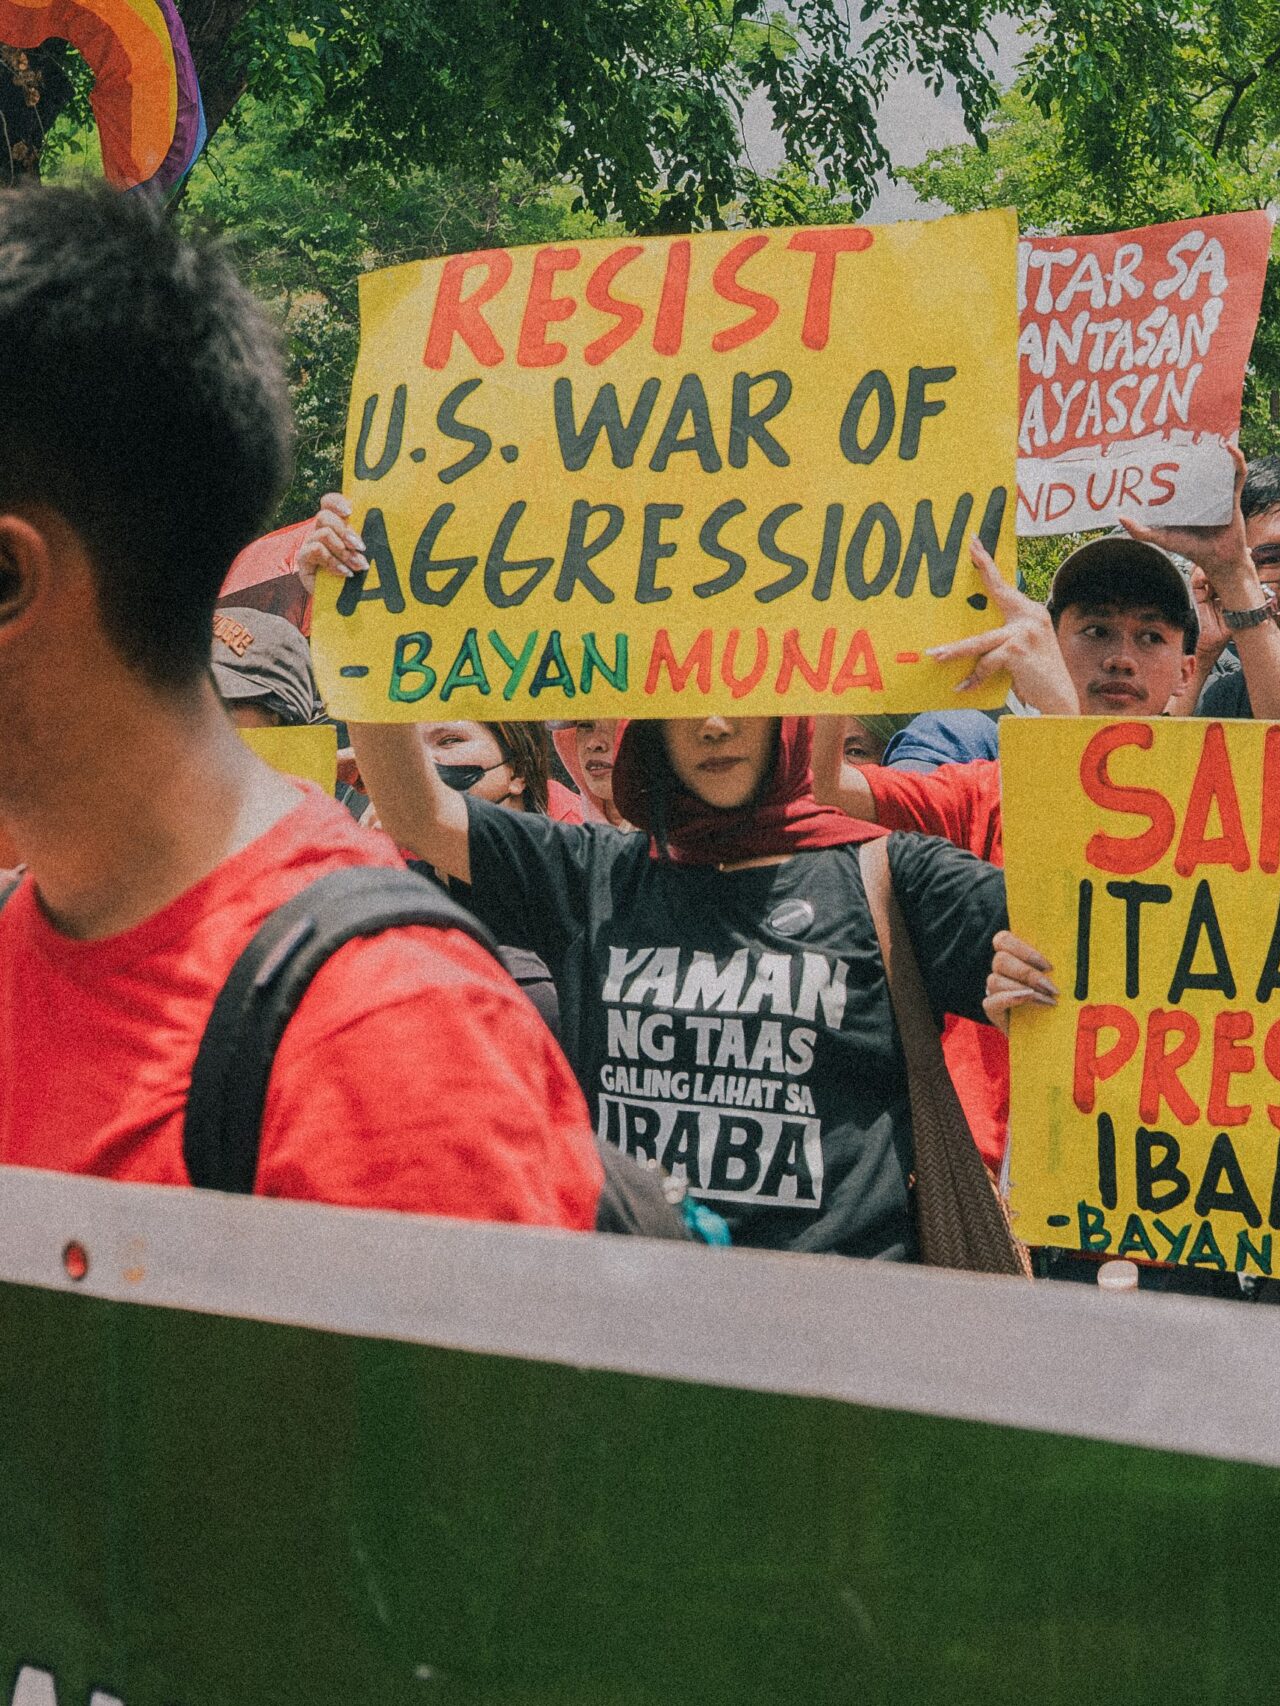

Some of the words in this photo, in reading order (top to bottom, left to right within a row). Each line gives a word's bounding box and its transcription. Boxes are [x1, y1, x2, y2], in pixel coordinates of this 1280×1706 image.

[422, 227, 874, 370] RESIST
[1153, 230, 1228, 300] SA
[354, 377, 519, 484] U.S.
[553, 370, 792, 474] WAR
[839, 366, 957, 466] OF
[1018, 363, 1203, 455] AYASIN
[1086, 462, 1180, 512] URS
[336, 486, 1007, 616] AGGRESSION!
[602, 945, 849, 1030] YAMAN
[607, 1008, 675, 1062] NG
[686, 1015, 817, 1076] TAAS
[601, 1063, 690, 1101] GALING
[694, 1072, 784, 1110] LAHAT
[785, 1083, 816, 1115] SA
